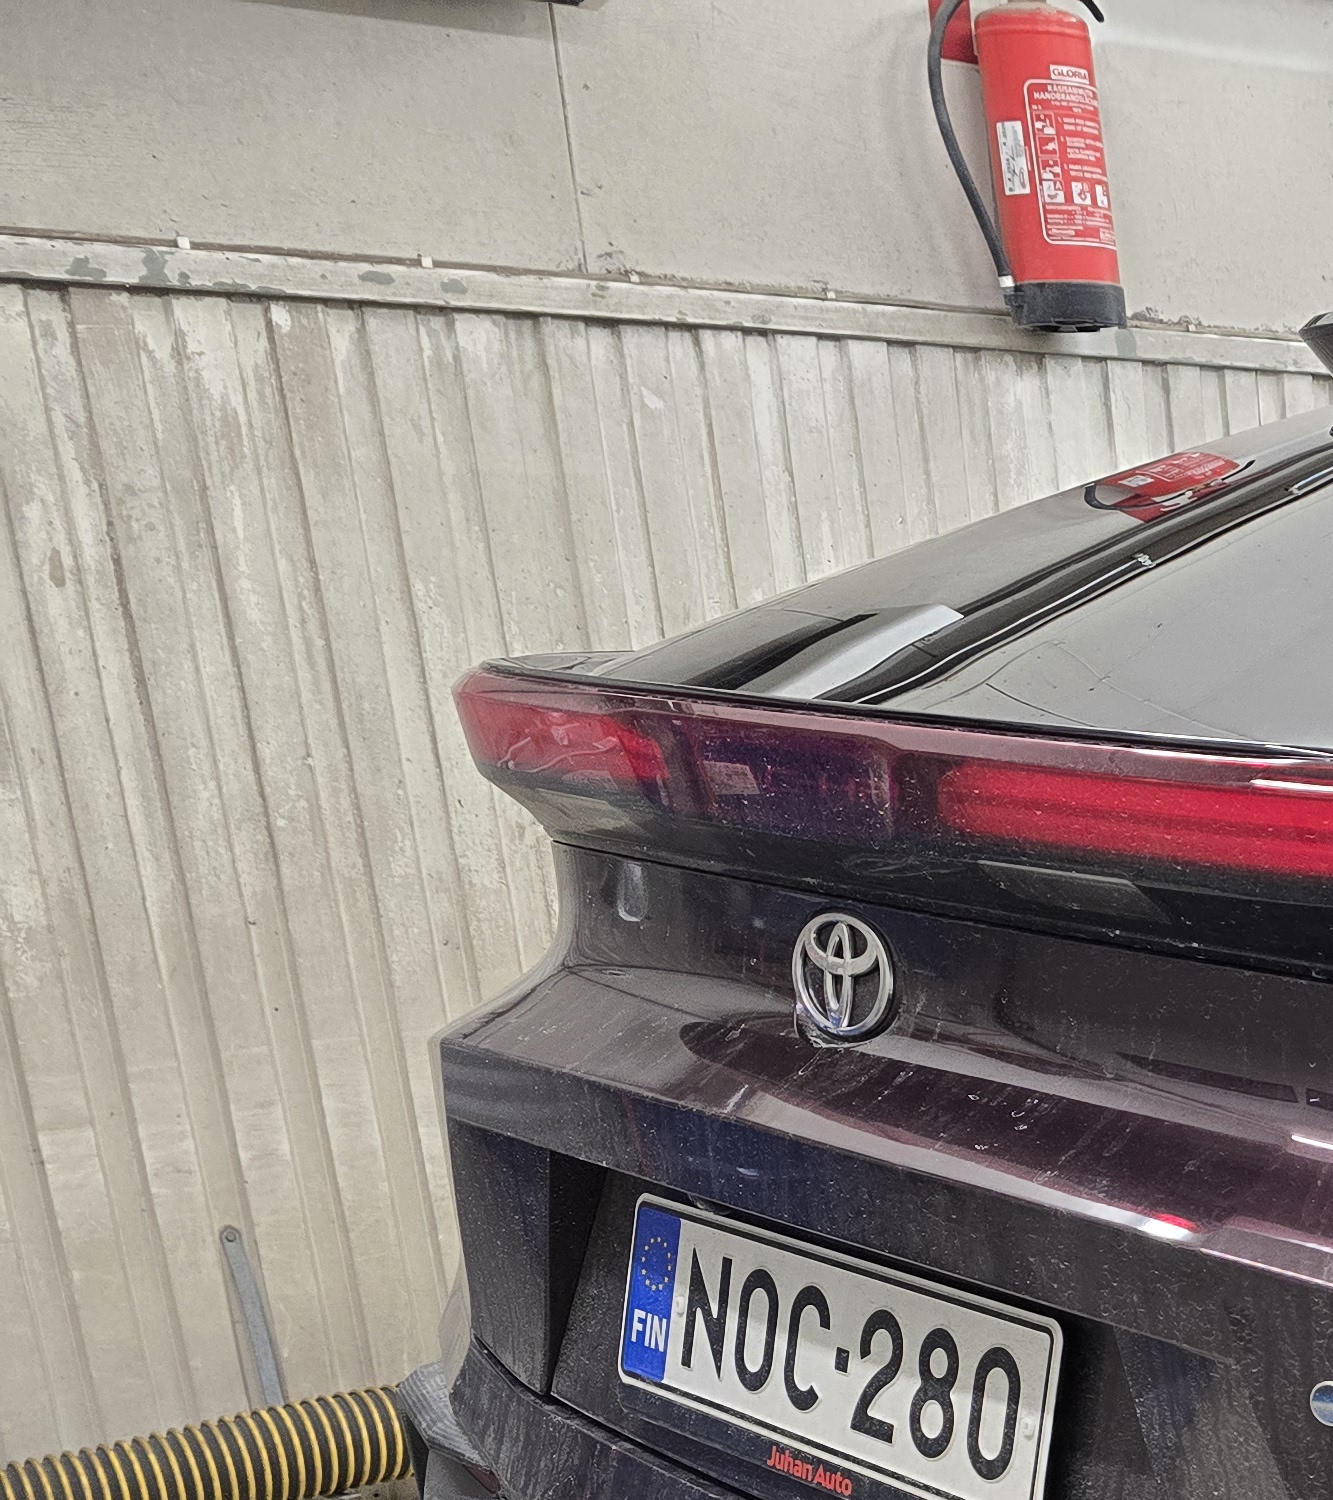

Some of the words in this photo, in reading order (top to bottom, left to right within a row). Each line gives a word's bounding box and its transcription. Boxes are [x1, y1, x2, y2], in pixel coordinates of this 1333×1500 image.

[1052, 67, 1088, 80] GLORIA
[630, 1309, 667, 1353] FIN
[681, 1247, 1021, 1481] NOC-280
[766, 1446, 813, 1482] Juhan
[812, 1465, 853, 1497] Auto
